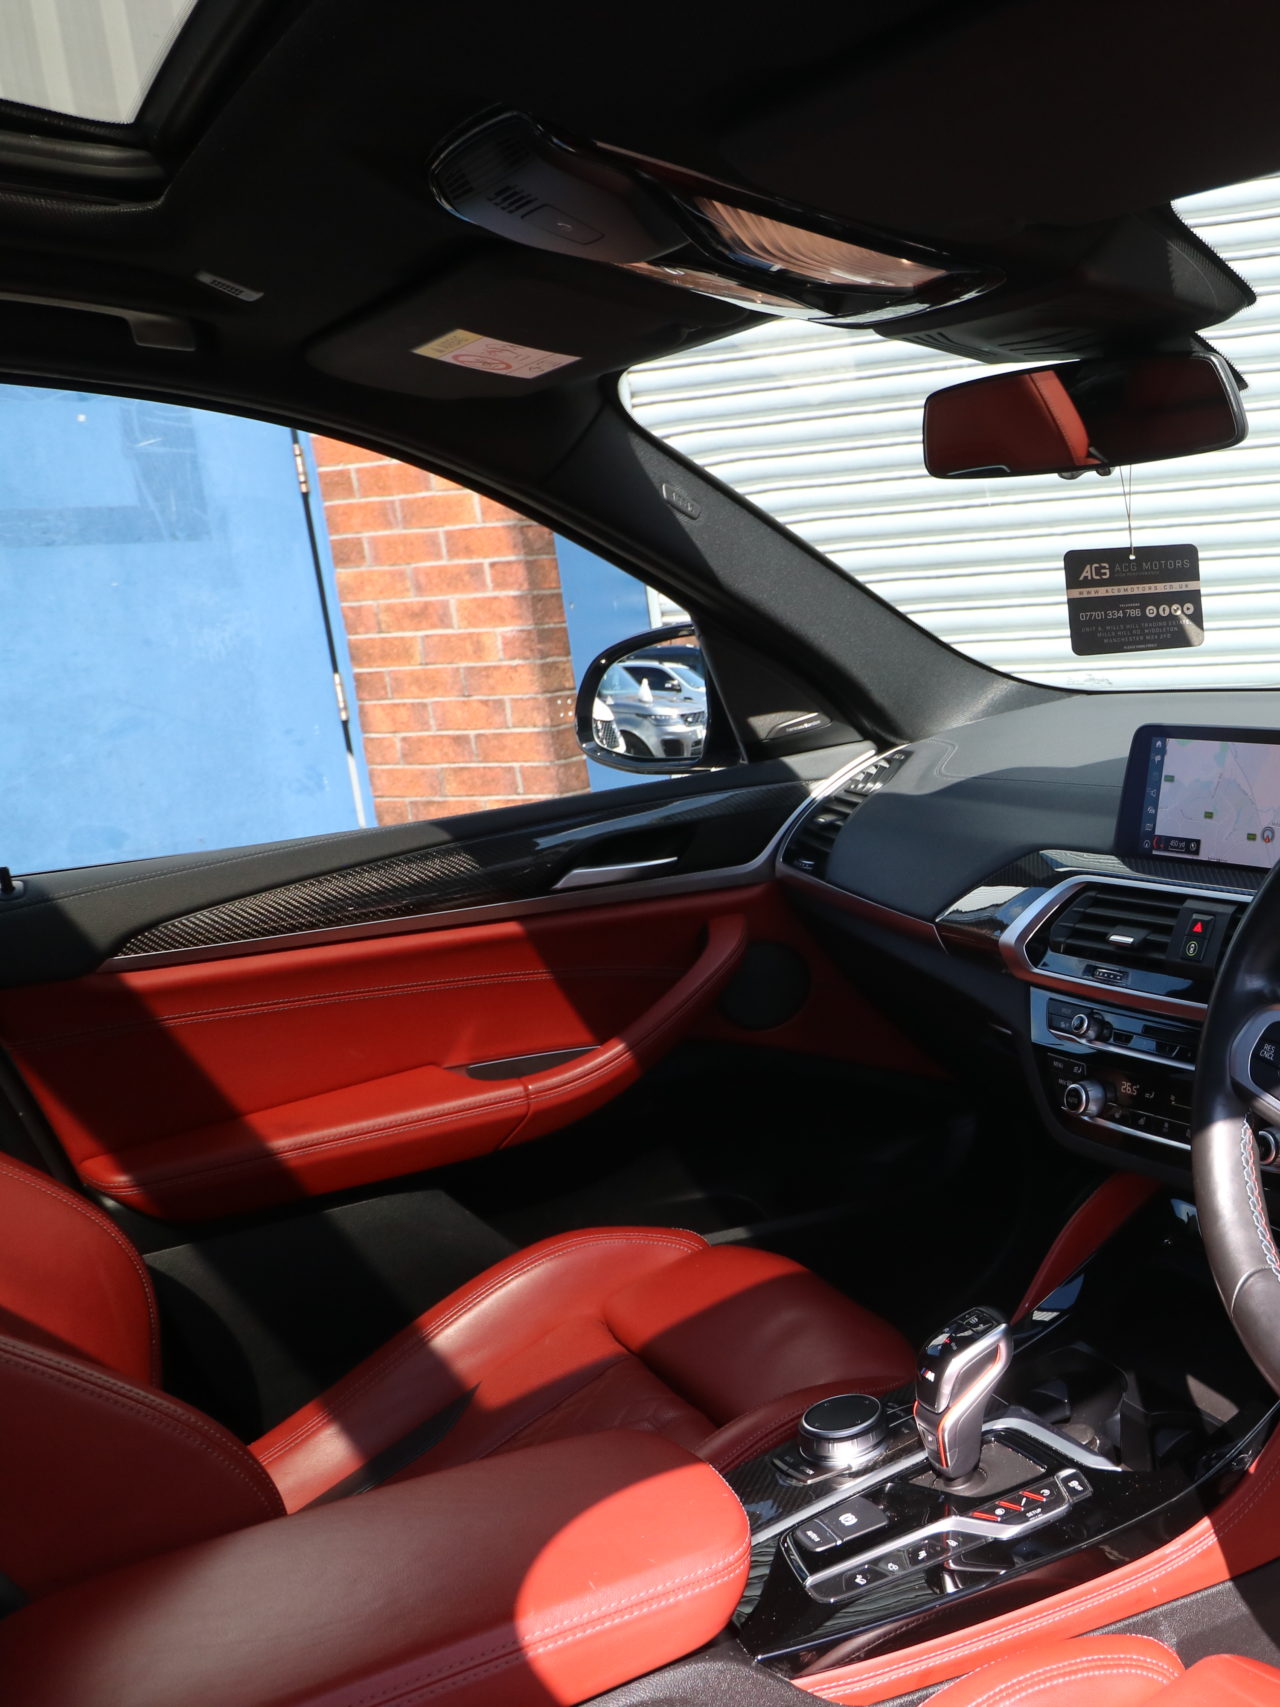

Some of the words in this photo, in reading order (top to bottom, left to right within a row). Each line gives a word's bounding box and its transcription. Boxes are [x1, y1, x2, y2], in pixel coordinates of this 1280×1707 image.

[1079, 562, 1110, 581] ACG
[1114, 562, 1137, 573] ACG
[1143, 559, 1190, 571] MOTORS
[1079, 610, 1105, 621] 07701
[1107, 609, 1123, 619] 334
[1263, 1043, 1276, 1053] RES
[1259, 1050, 1275, 1061] CNCL
